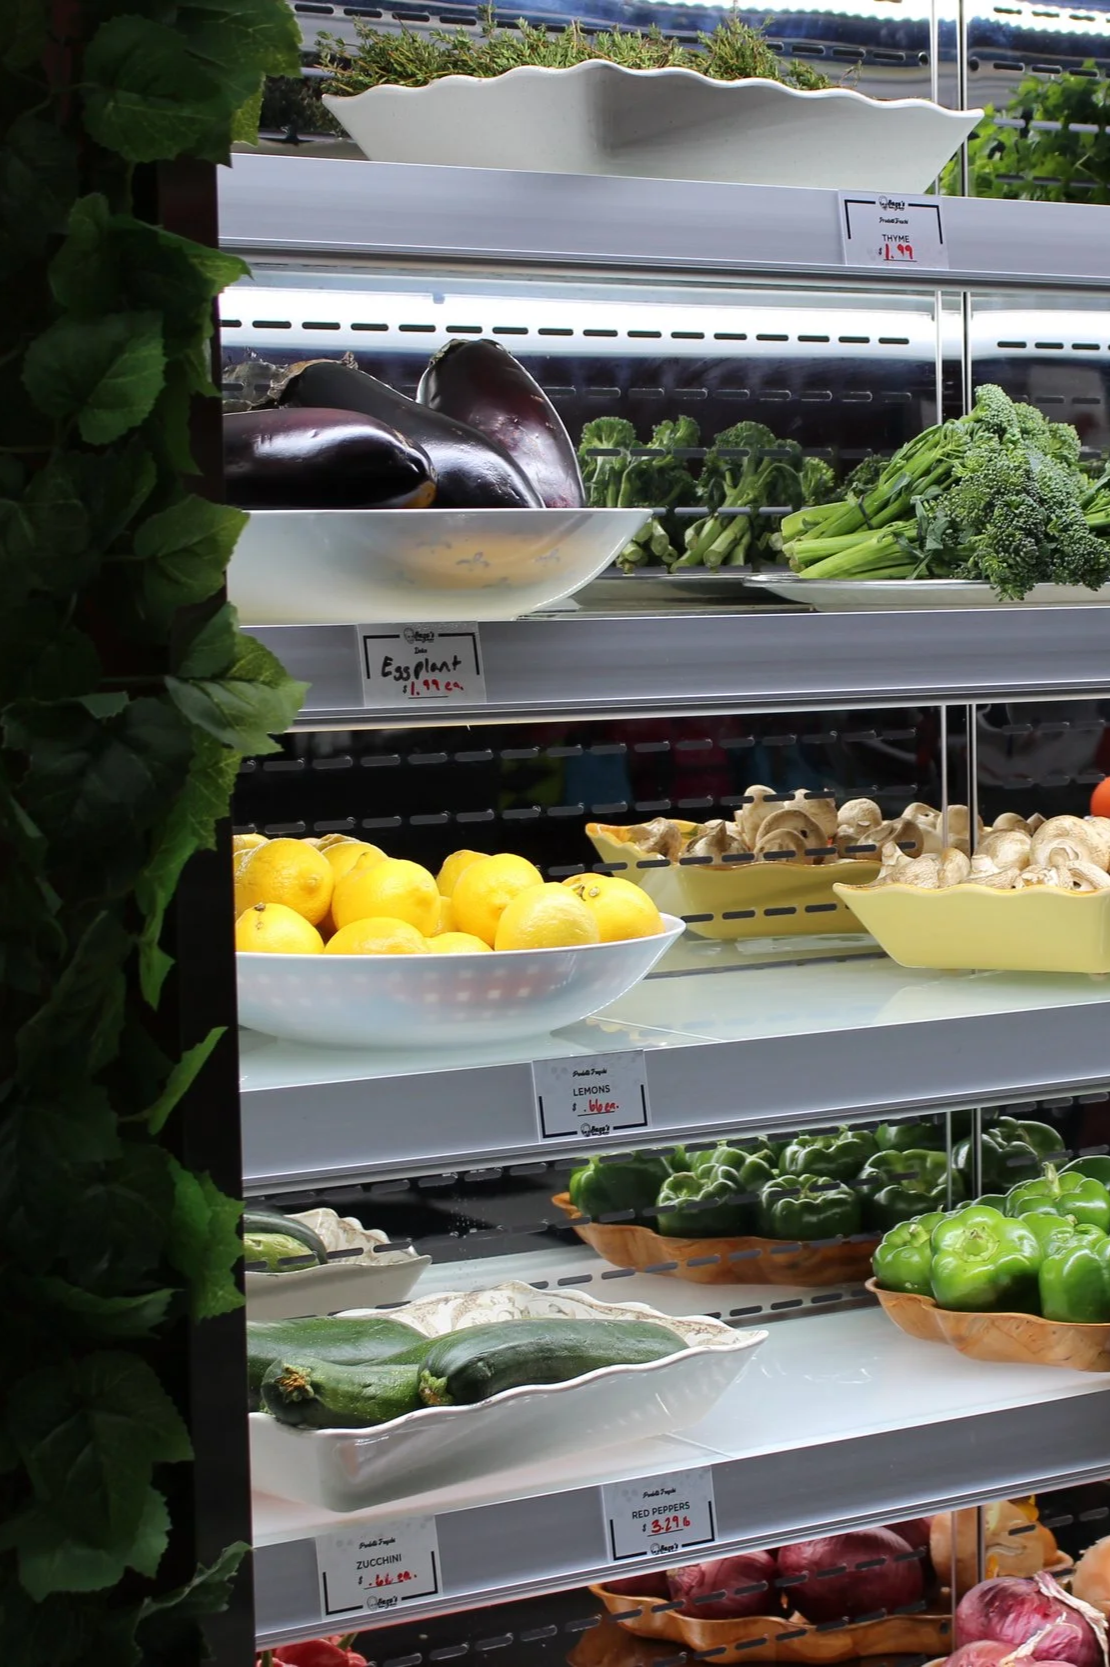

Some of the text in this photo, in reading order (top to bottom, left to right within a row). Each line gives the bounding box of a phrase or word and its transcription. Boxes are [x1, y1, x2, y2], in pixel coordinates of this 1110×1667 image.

[882, 234, 910, 243] THYME
[573, 1085, 611, 1097] LEMONS
[632, 1501, 691, 1519] RED PEPPERS
[356, 1554, 402, 1570] ZUCCHINI
